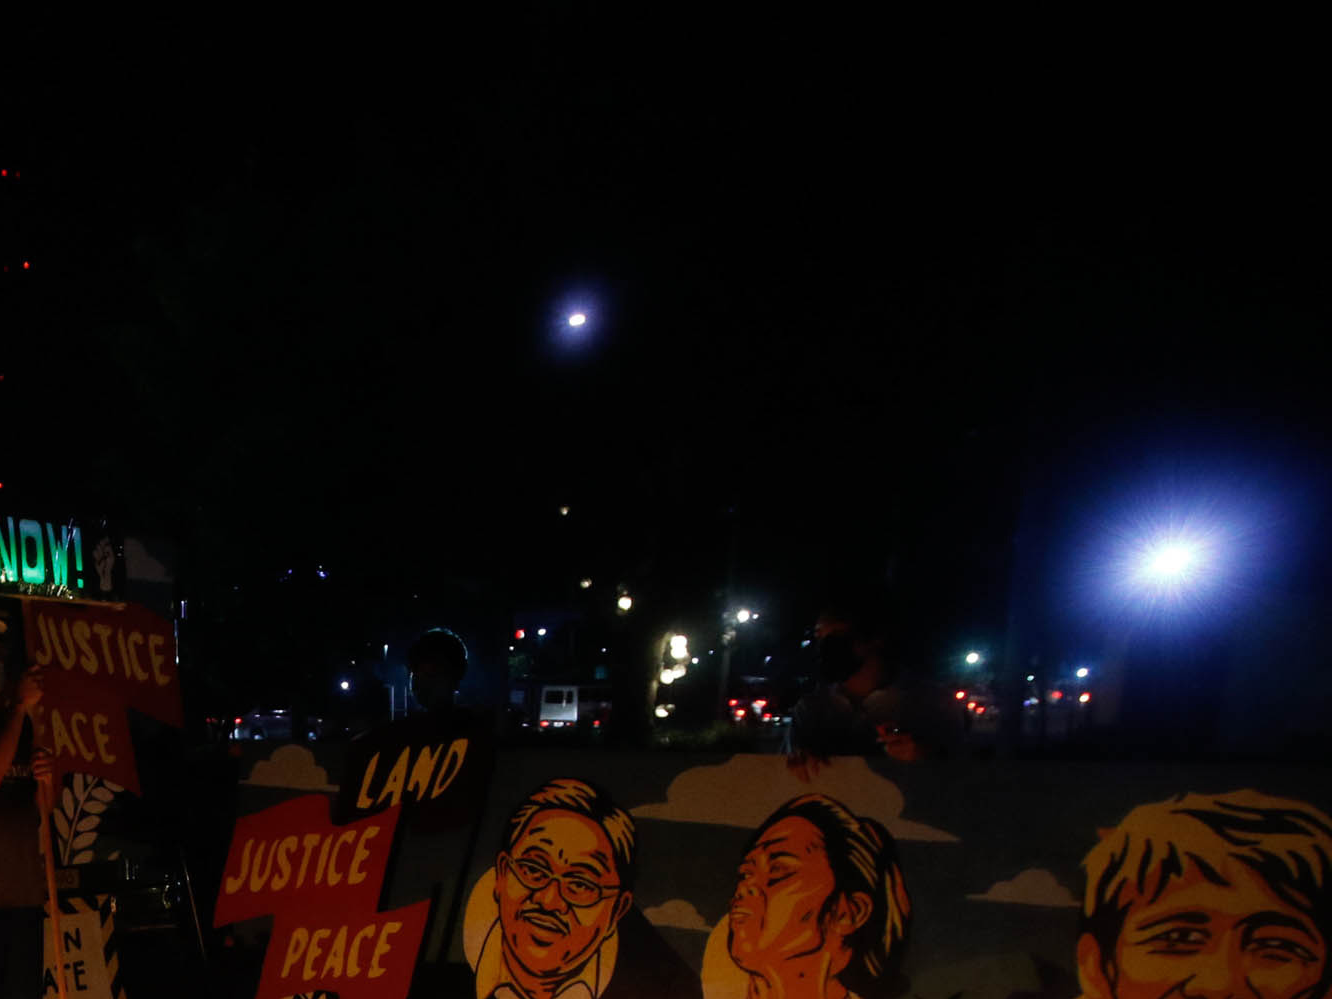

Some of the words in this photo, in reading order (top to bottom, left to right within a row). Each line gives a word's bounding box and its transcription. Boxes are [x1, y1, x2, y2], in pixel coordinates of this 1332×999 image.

[35, 611, 173, 687] JUSTICE
[356, 738, 468, 809] LAND
[225, 826, 379, 895] JUSTICE
[280, 921, 403, 982] PEACE
